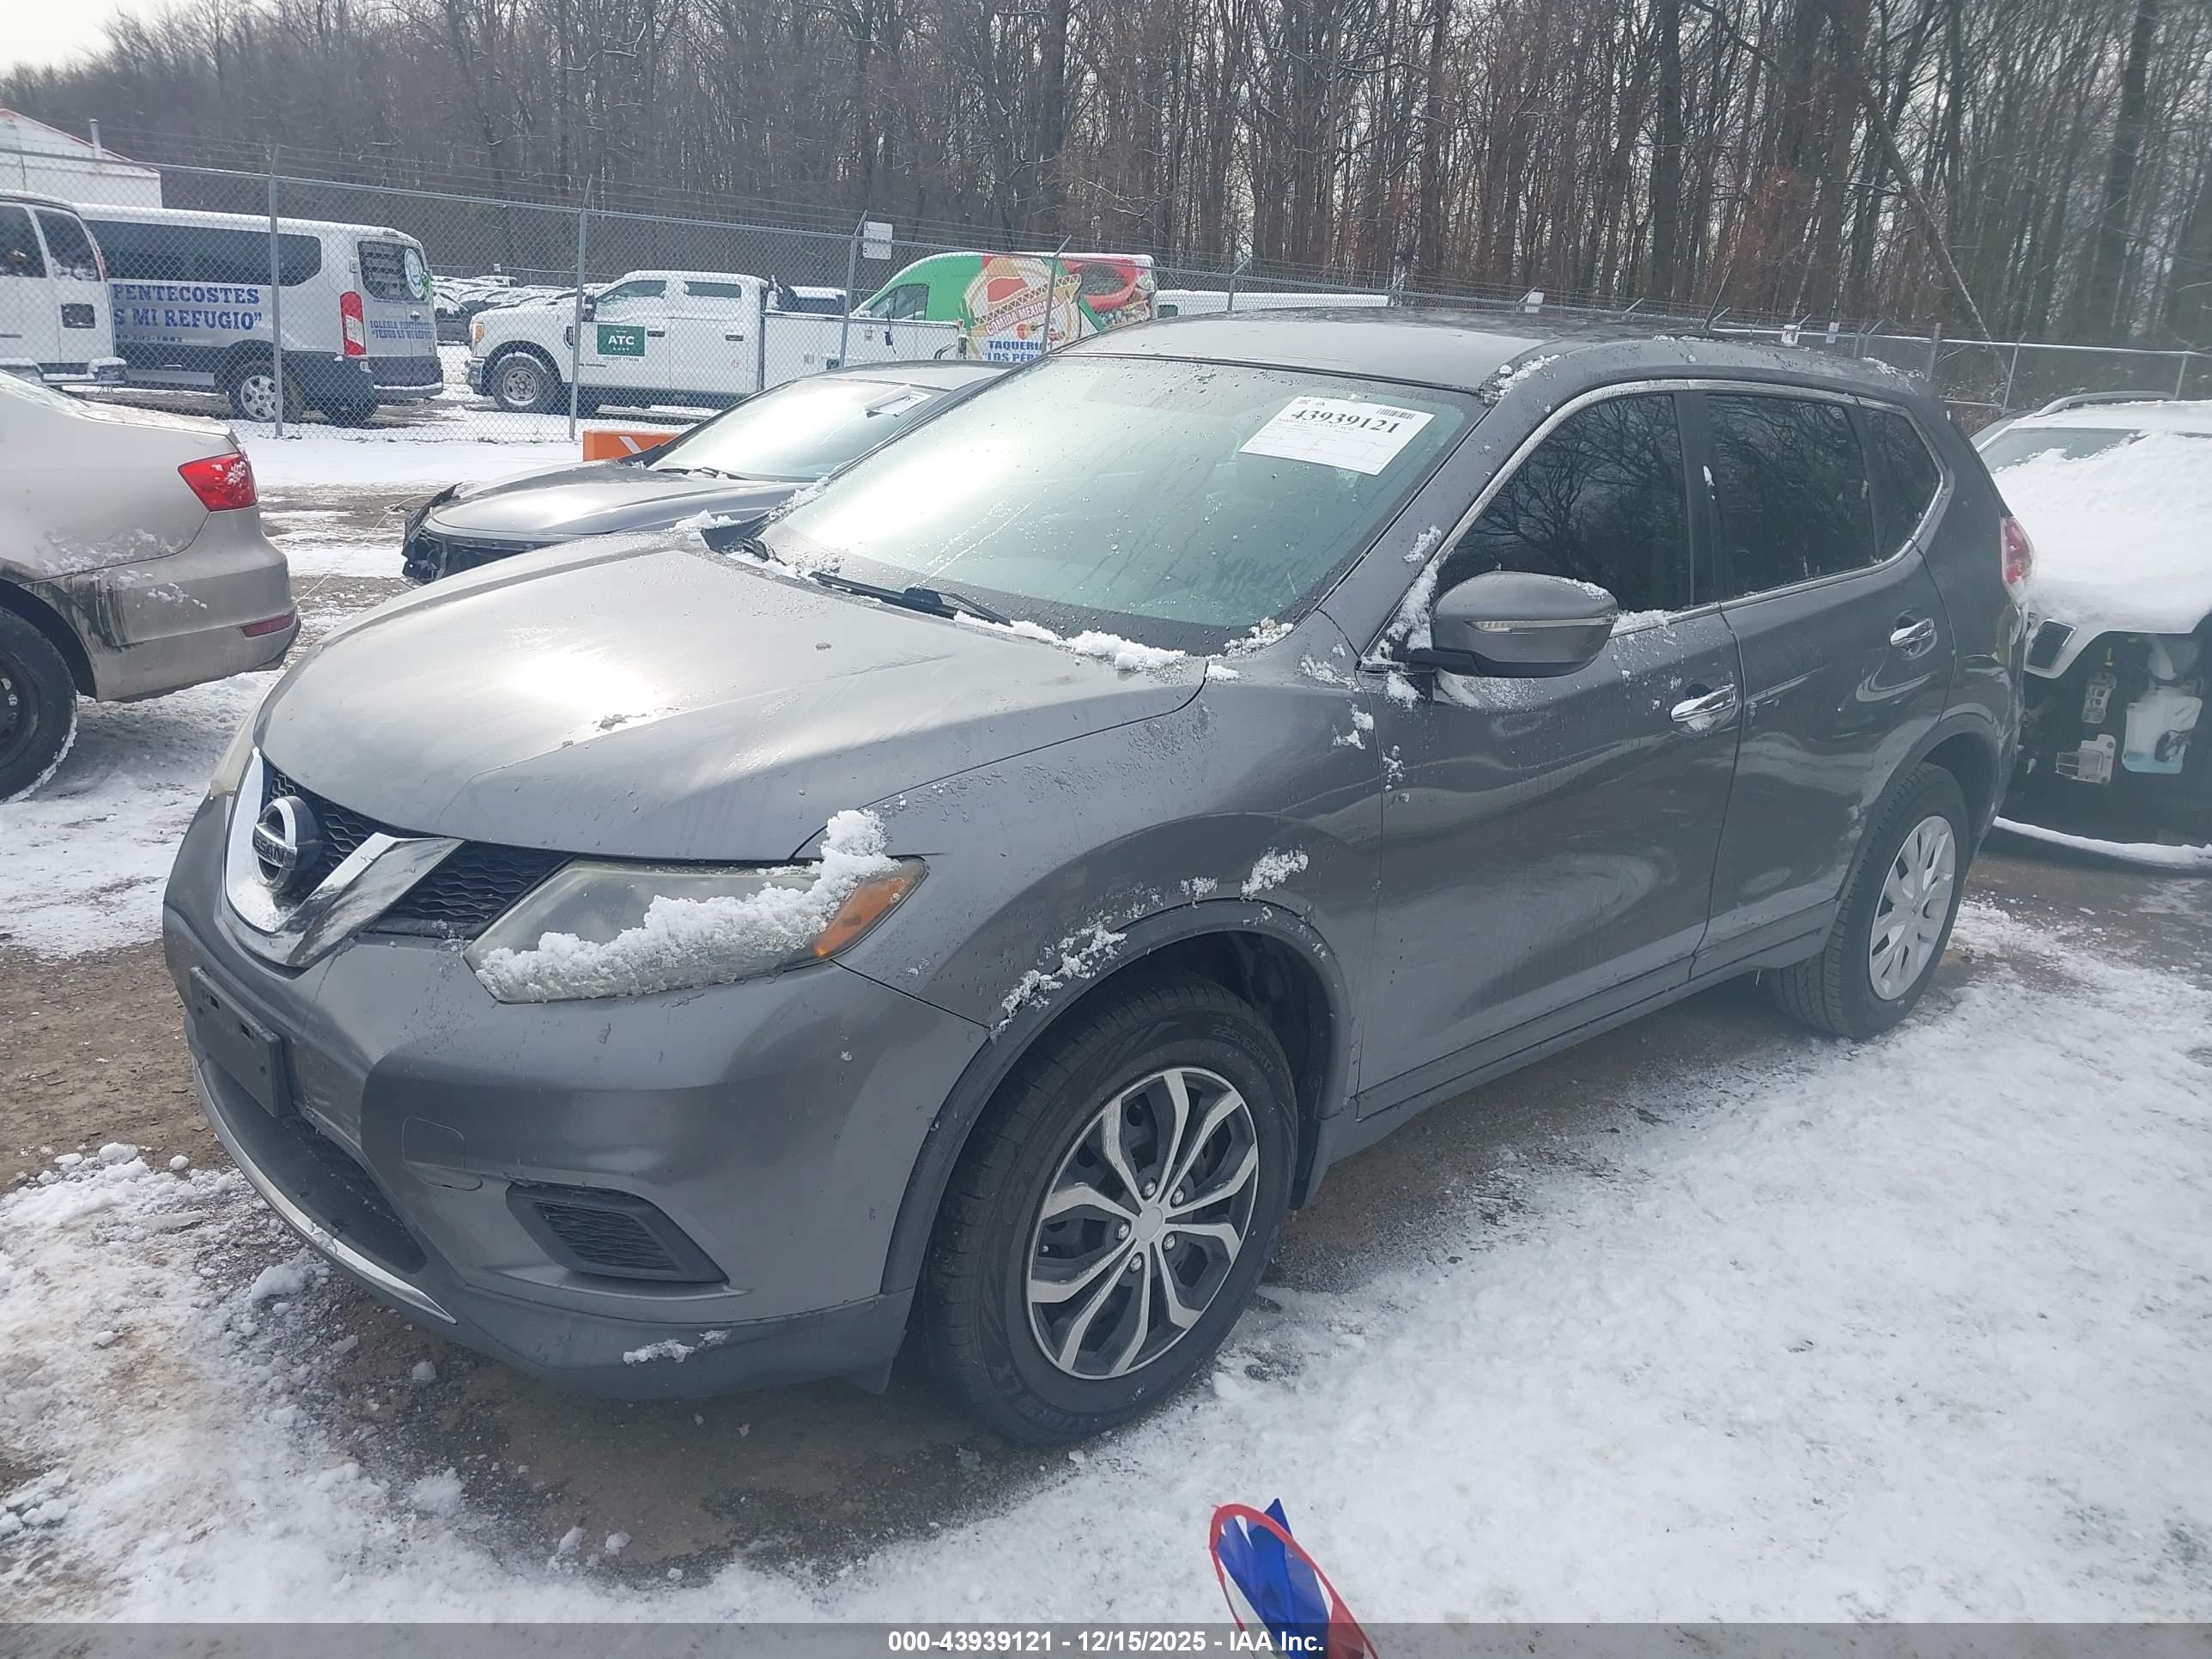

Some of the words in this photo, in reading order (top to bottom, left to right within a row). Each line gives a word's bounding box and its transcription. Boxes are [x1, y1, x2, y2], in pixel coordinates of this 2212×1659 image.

[112, 284, 260, 304] PENTECOSTES
[132, 308, 159, 326] MI
[986, 308, 1019, 335] COMIDA
[1018, 295, 1061, 320] MEXICA
[607, 335, 635, 345] ATC
[1291, 409, 1401, 434] 43939121
